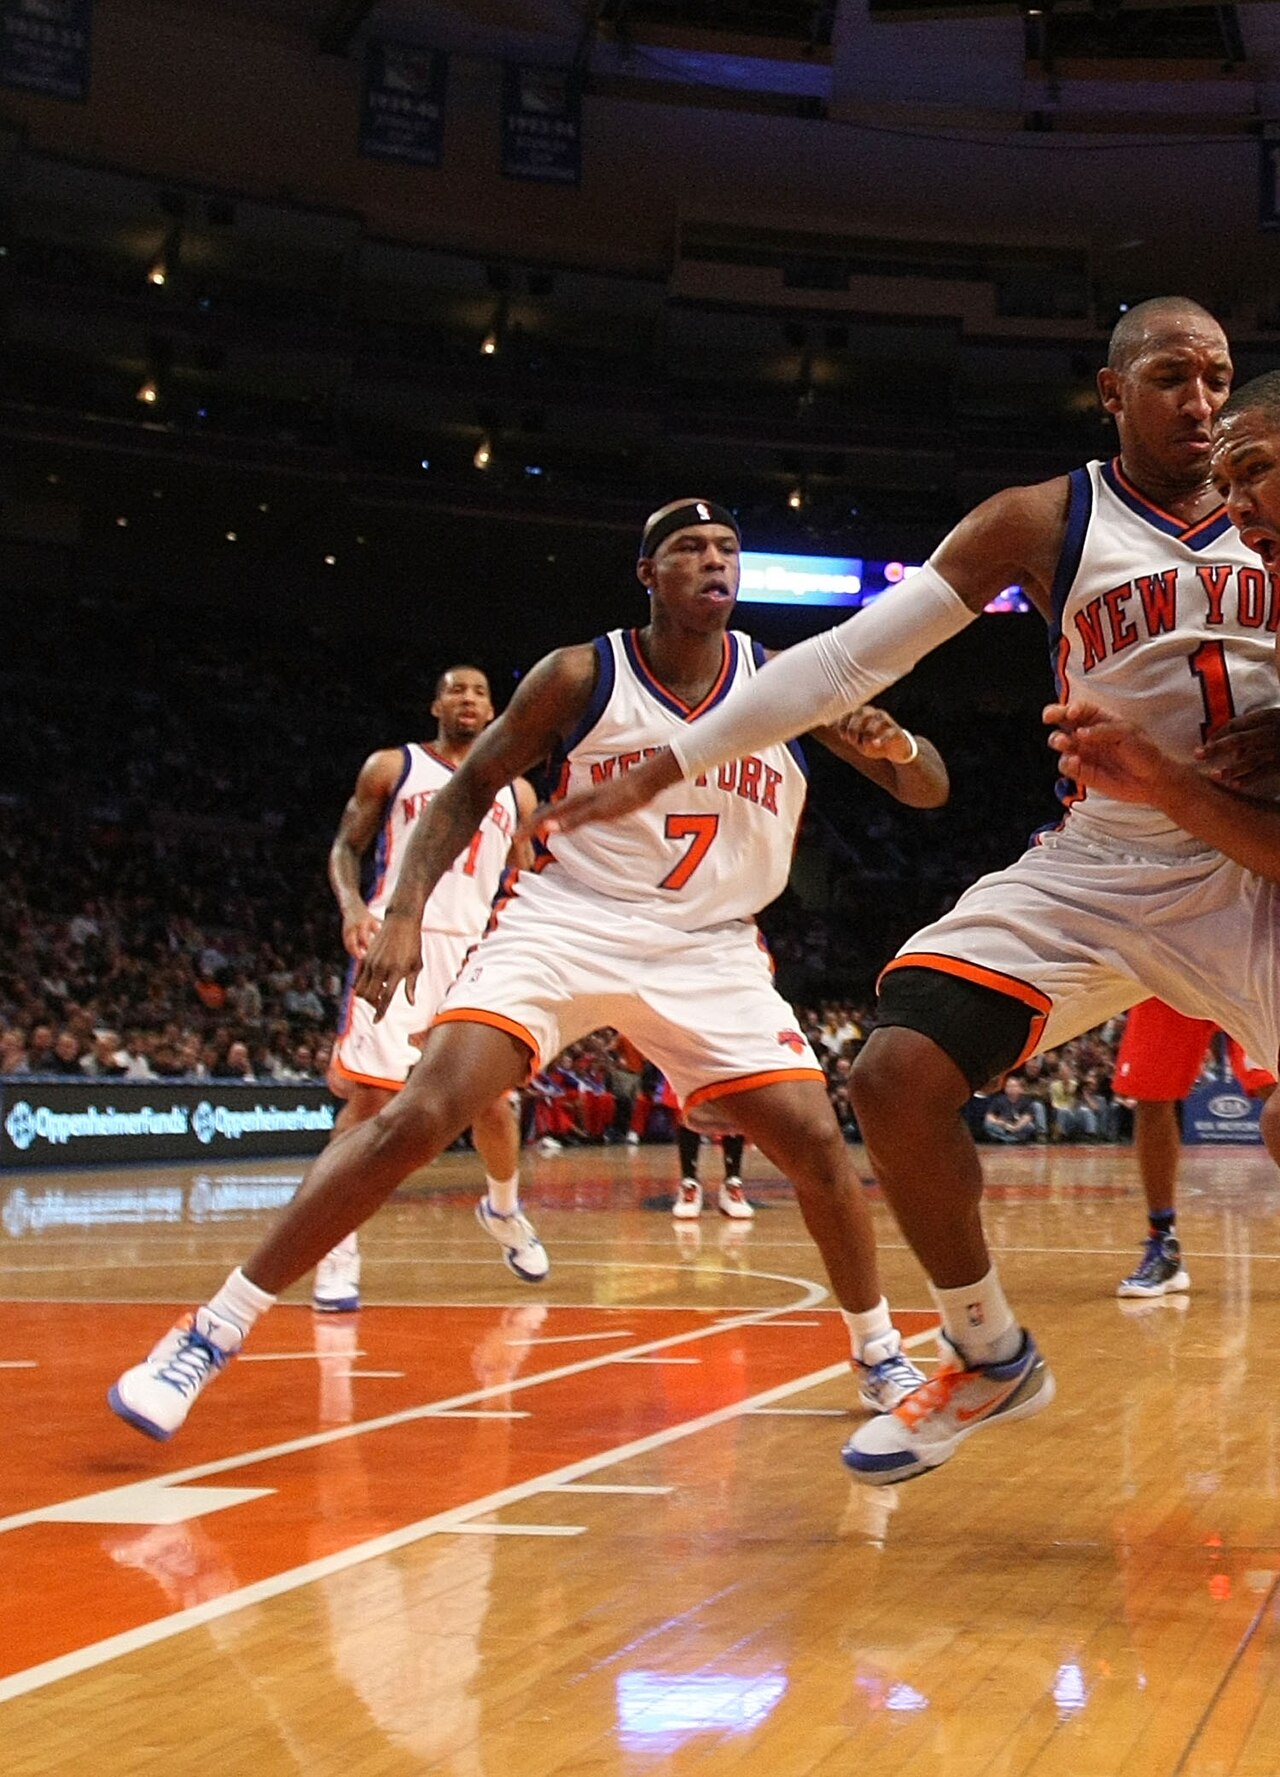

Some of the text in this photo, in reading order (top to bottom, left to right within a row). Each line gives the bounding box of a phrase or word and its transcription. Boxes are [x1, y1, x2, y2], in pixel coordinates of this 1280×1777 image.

[1074, 567, 1179, 673] NEW
[1188, 640, 1236, 745] 1
[658, 813, 719, 891] 7
